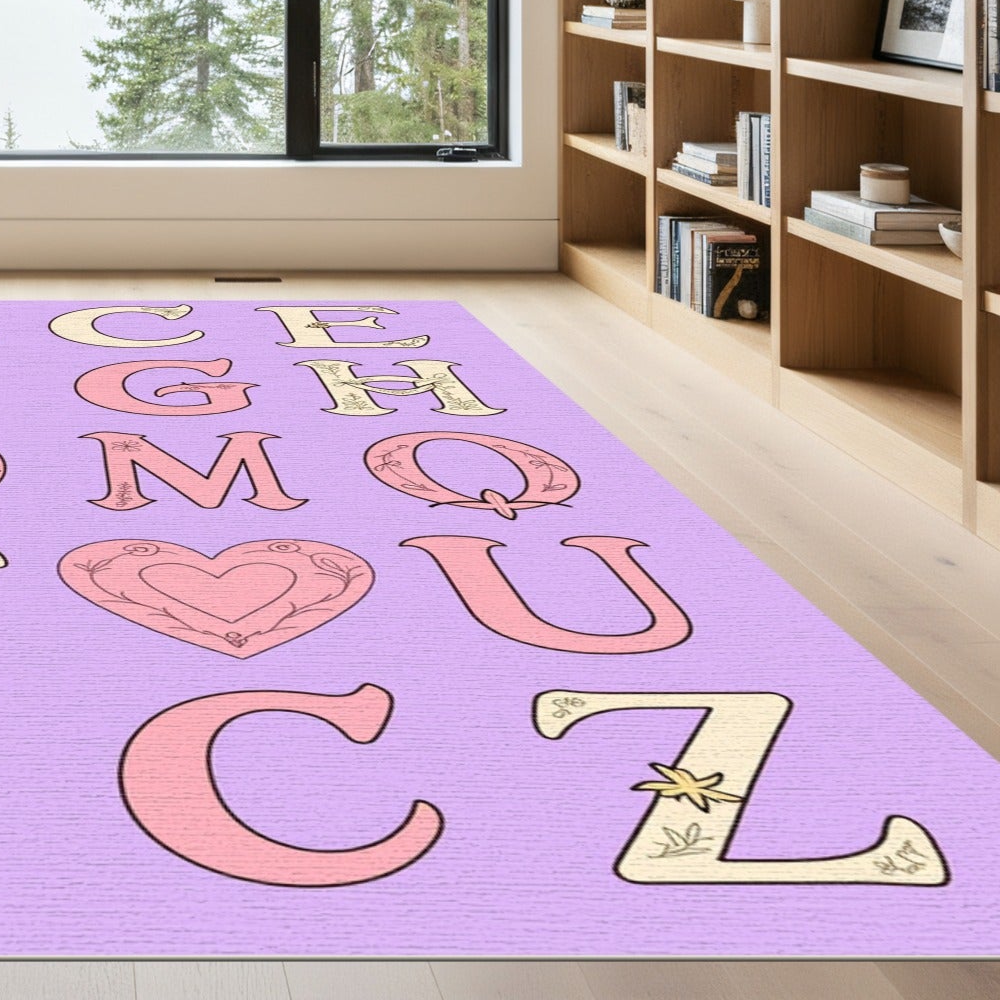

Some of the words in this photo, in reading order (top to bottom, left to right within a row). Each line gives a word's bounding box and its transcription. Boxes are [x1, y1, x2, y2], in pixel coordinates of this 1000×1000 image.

[48, 304, 205, 348] C
[255, 305, 430, 348] E
[74, 358, 260, 416] G
[293, 359, 507, 416] H
[78, 431, 309, 511] M
[363, 431, 581, 520] Q
[399, 535, 693, 655] U
[117, 683, 445, 886] C
[532, 690, 952, 886] Z
